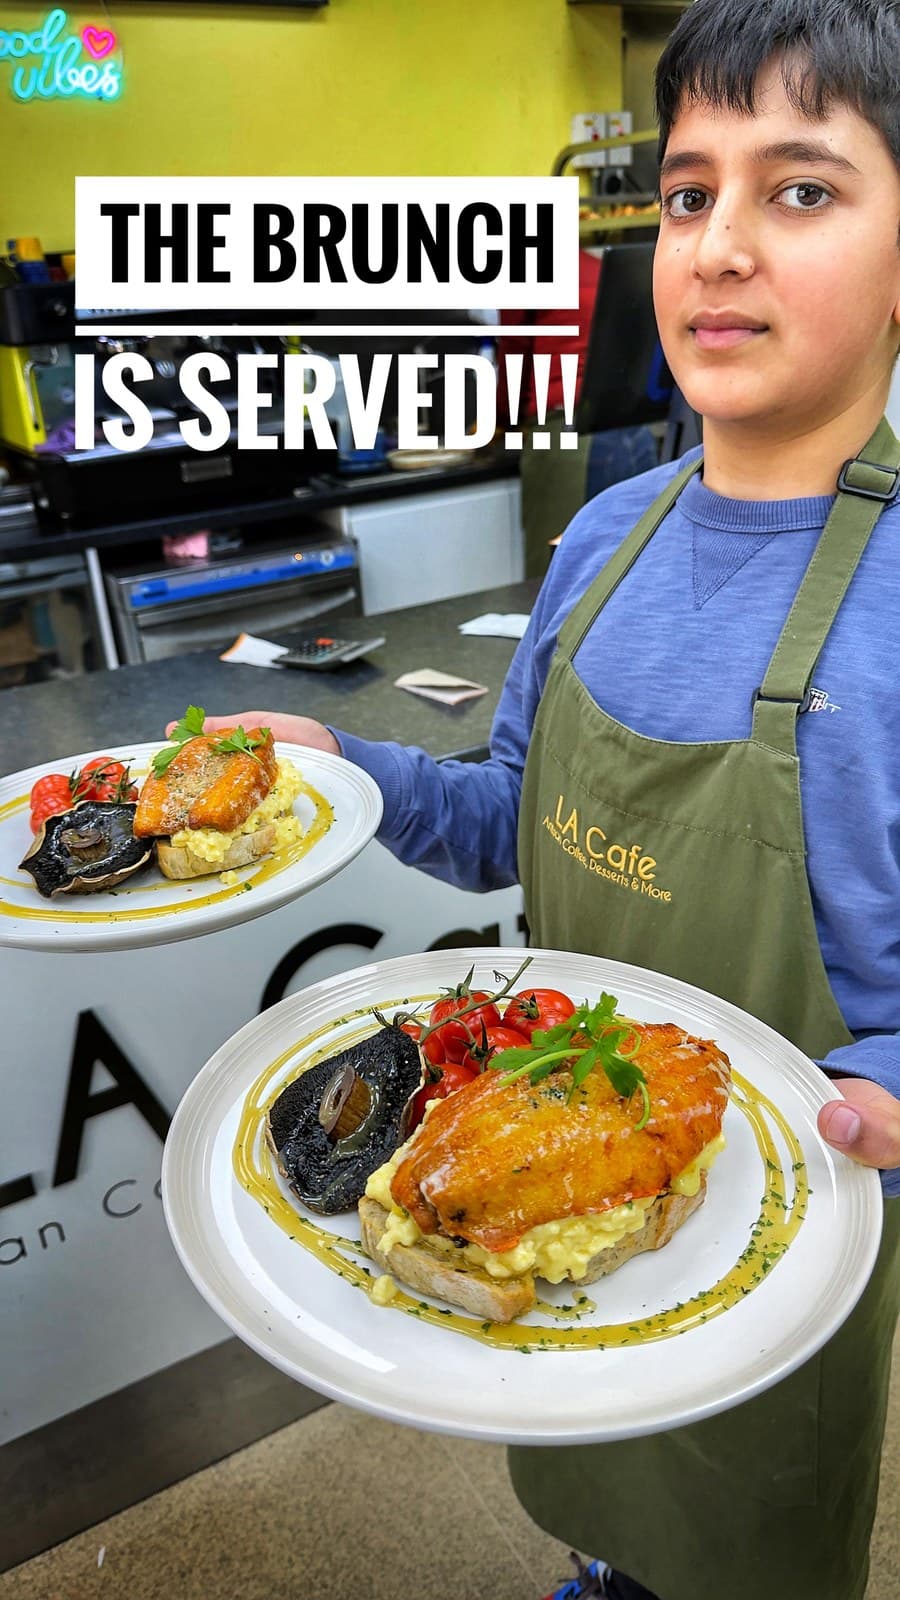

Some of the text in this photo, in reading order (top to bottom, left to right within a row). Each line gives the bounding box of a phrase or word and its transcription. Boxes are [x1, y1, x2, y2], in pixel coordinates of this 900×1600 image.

[13, 36, 121, 99] vibes
[555, 794, 657, 880] LA Cafe
[589, 858, 629, 888] Desserts
[630, 877, 639, 890] &
[641, 881, 672, 901] More
